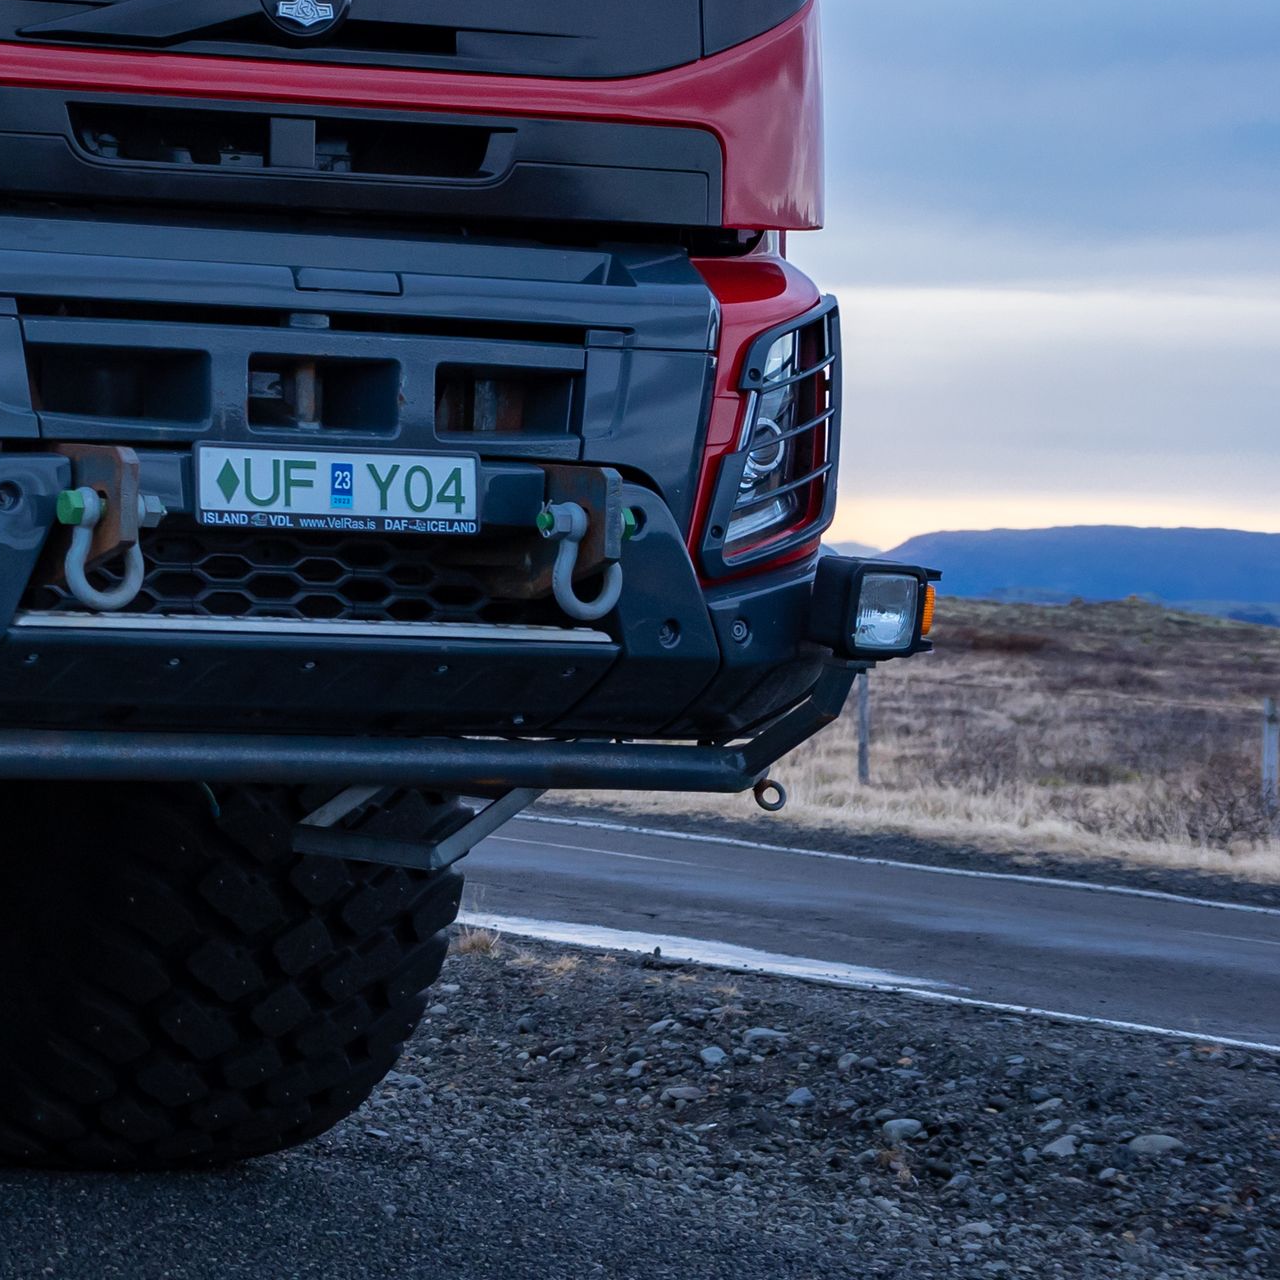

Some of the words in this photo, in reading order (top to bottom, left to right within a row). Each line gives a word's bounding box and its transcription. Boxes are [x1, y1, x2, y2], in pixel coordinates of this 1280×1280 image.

[244, 458, 317, 507] UF
[366, 463, 466, 514] Y04
[334, 470, 351, 490] 23
[333, 497, 351, 505] 2023
[203, 512, 248, 525] ISLAND
[268, 514, 294, 527] VDL
[299, 517, 377, 530] www.VelRas.is
[384, 519, 409, 531] DAF
[427, 521, 477, 533] ICELAND
